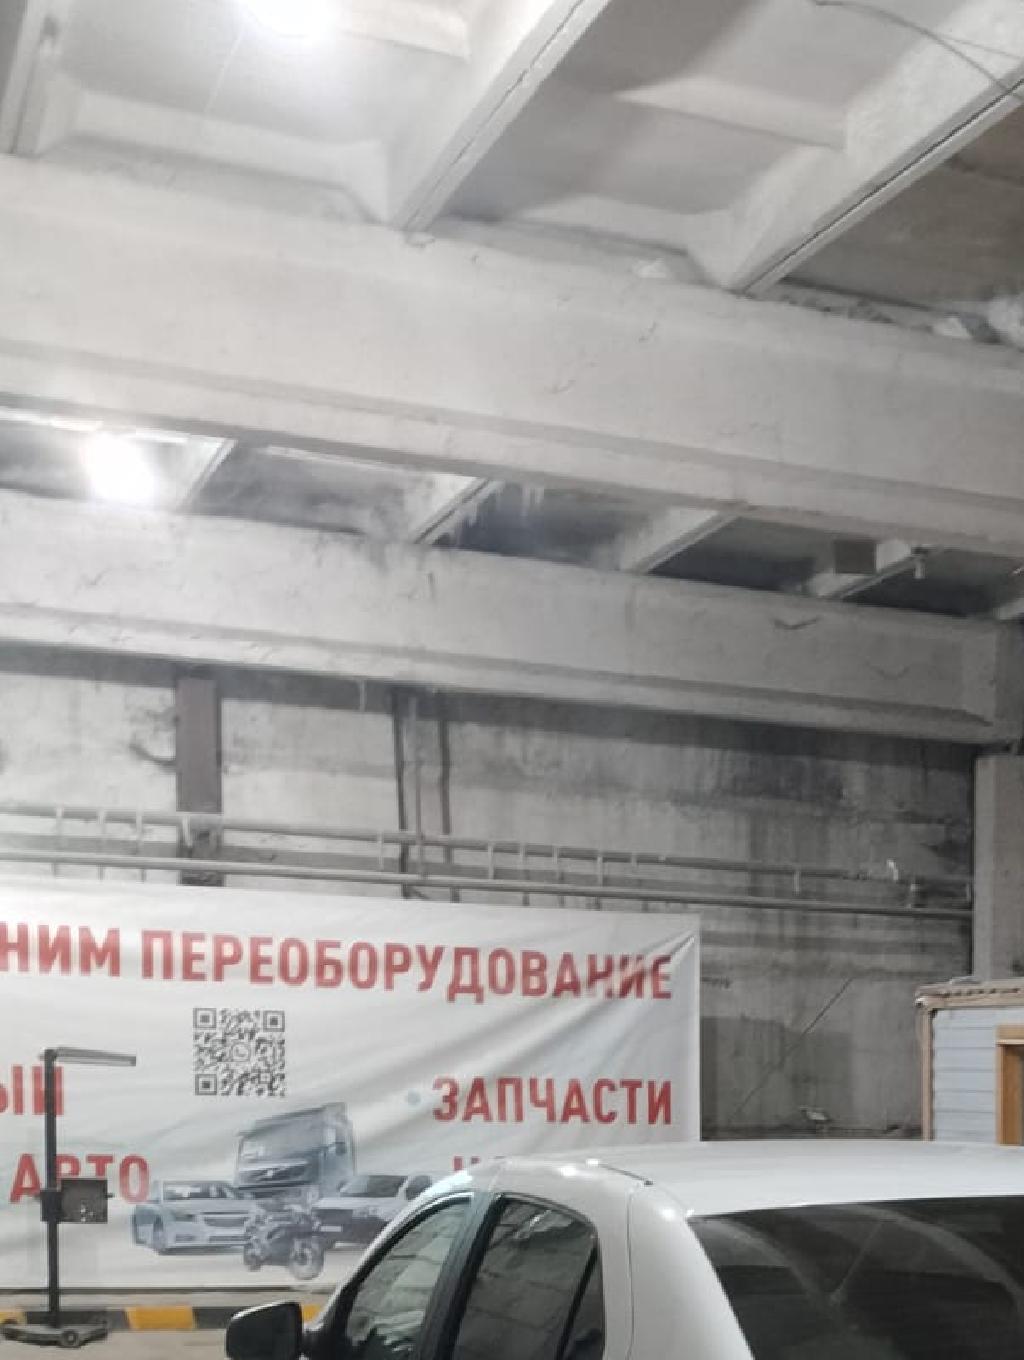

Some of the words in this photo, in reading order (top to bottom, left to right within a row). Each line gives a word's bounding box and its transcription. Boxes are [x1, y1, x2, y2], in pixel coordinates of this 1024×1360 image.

[0, 921, 120, 977] НИМ
[141, 930, 672, 1003] ПЕРЕОБОРУДОВАНИЕ
[432, 1076, 672, 1125] ЗАПЧАСТИ
